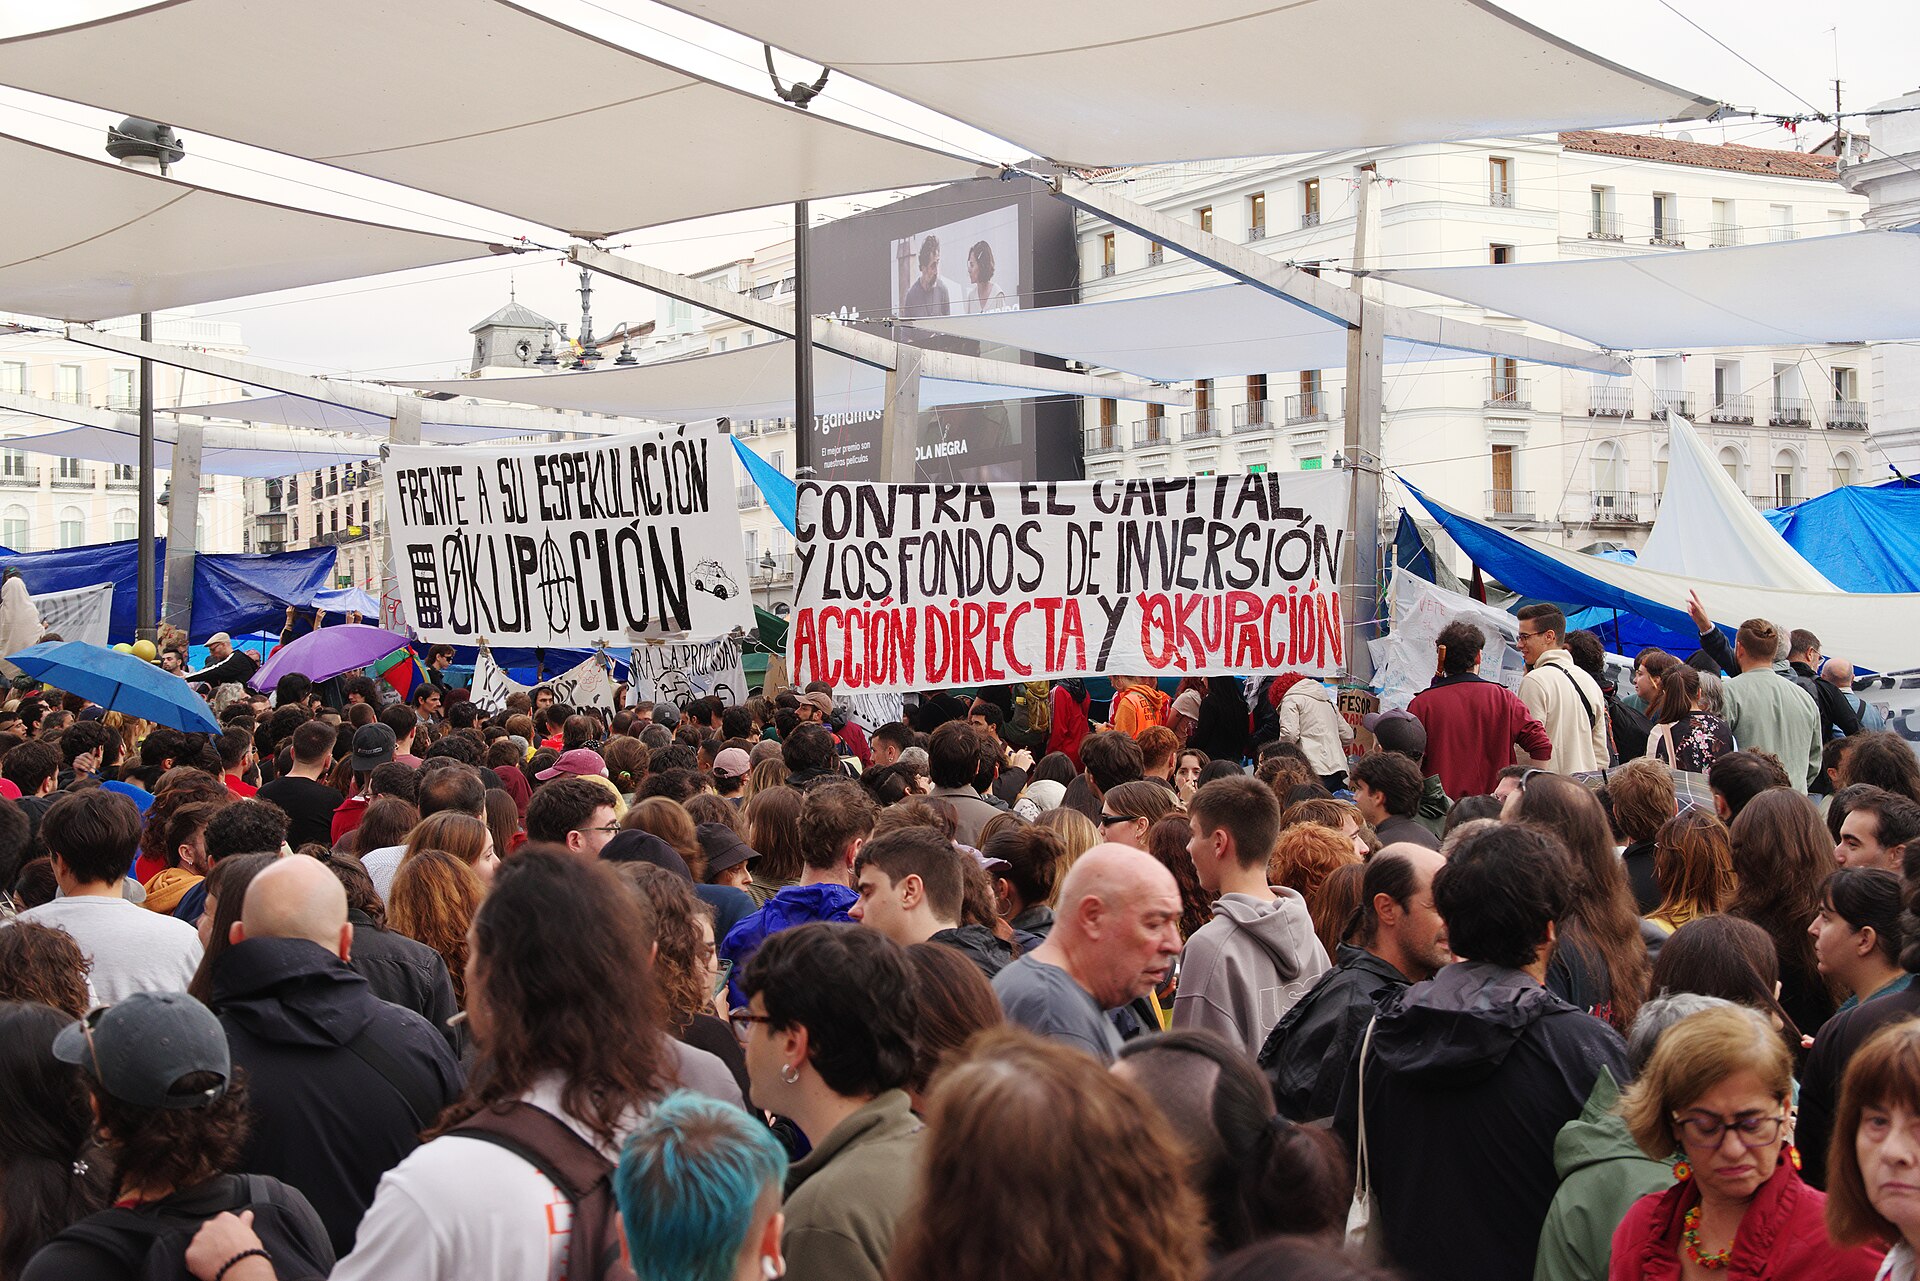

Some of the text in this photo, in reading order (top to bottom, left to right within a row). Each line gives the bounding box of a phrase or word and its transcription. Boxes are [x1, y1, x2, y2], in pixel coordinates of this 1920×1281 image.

[821, 441, 871, 457] El mejor premio son
[934, 439, 968, 458] NEGRA
[396, 425, 709, 527] FRENTE A SU ESPEKULACIÓN
[823, 458, 846, 469] nuestras
[796, 472, 1304, 543] CONTRA EL CAPITAL
[794, 512, 1343, 607] Y LOS FONDOS DE INVERSIÓN
[794, 595, 917, 688] ACCIÓN
[925, 596, 1087, 684] DIRECTA
[1095, 595, 1129, 672] Y
[658, 645, 679, 670] LA
[1336, 695, 1371, 714] FESOR
